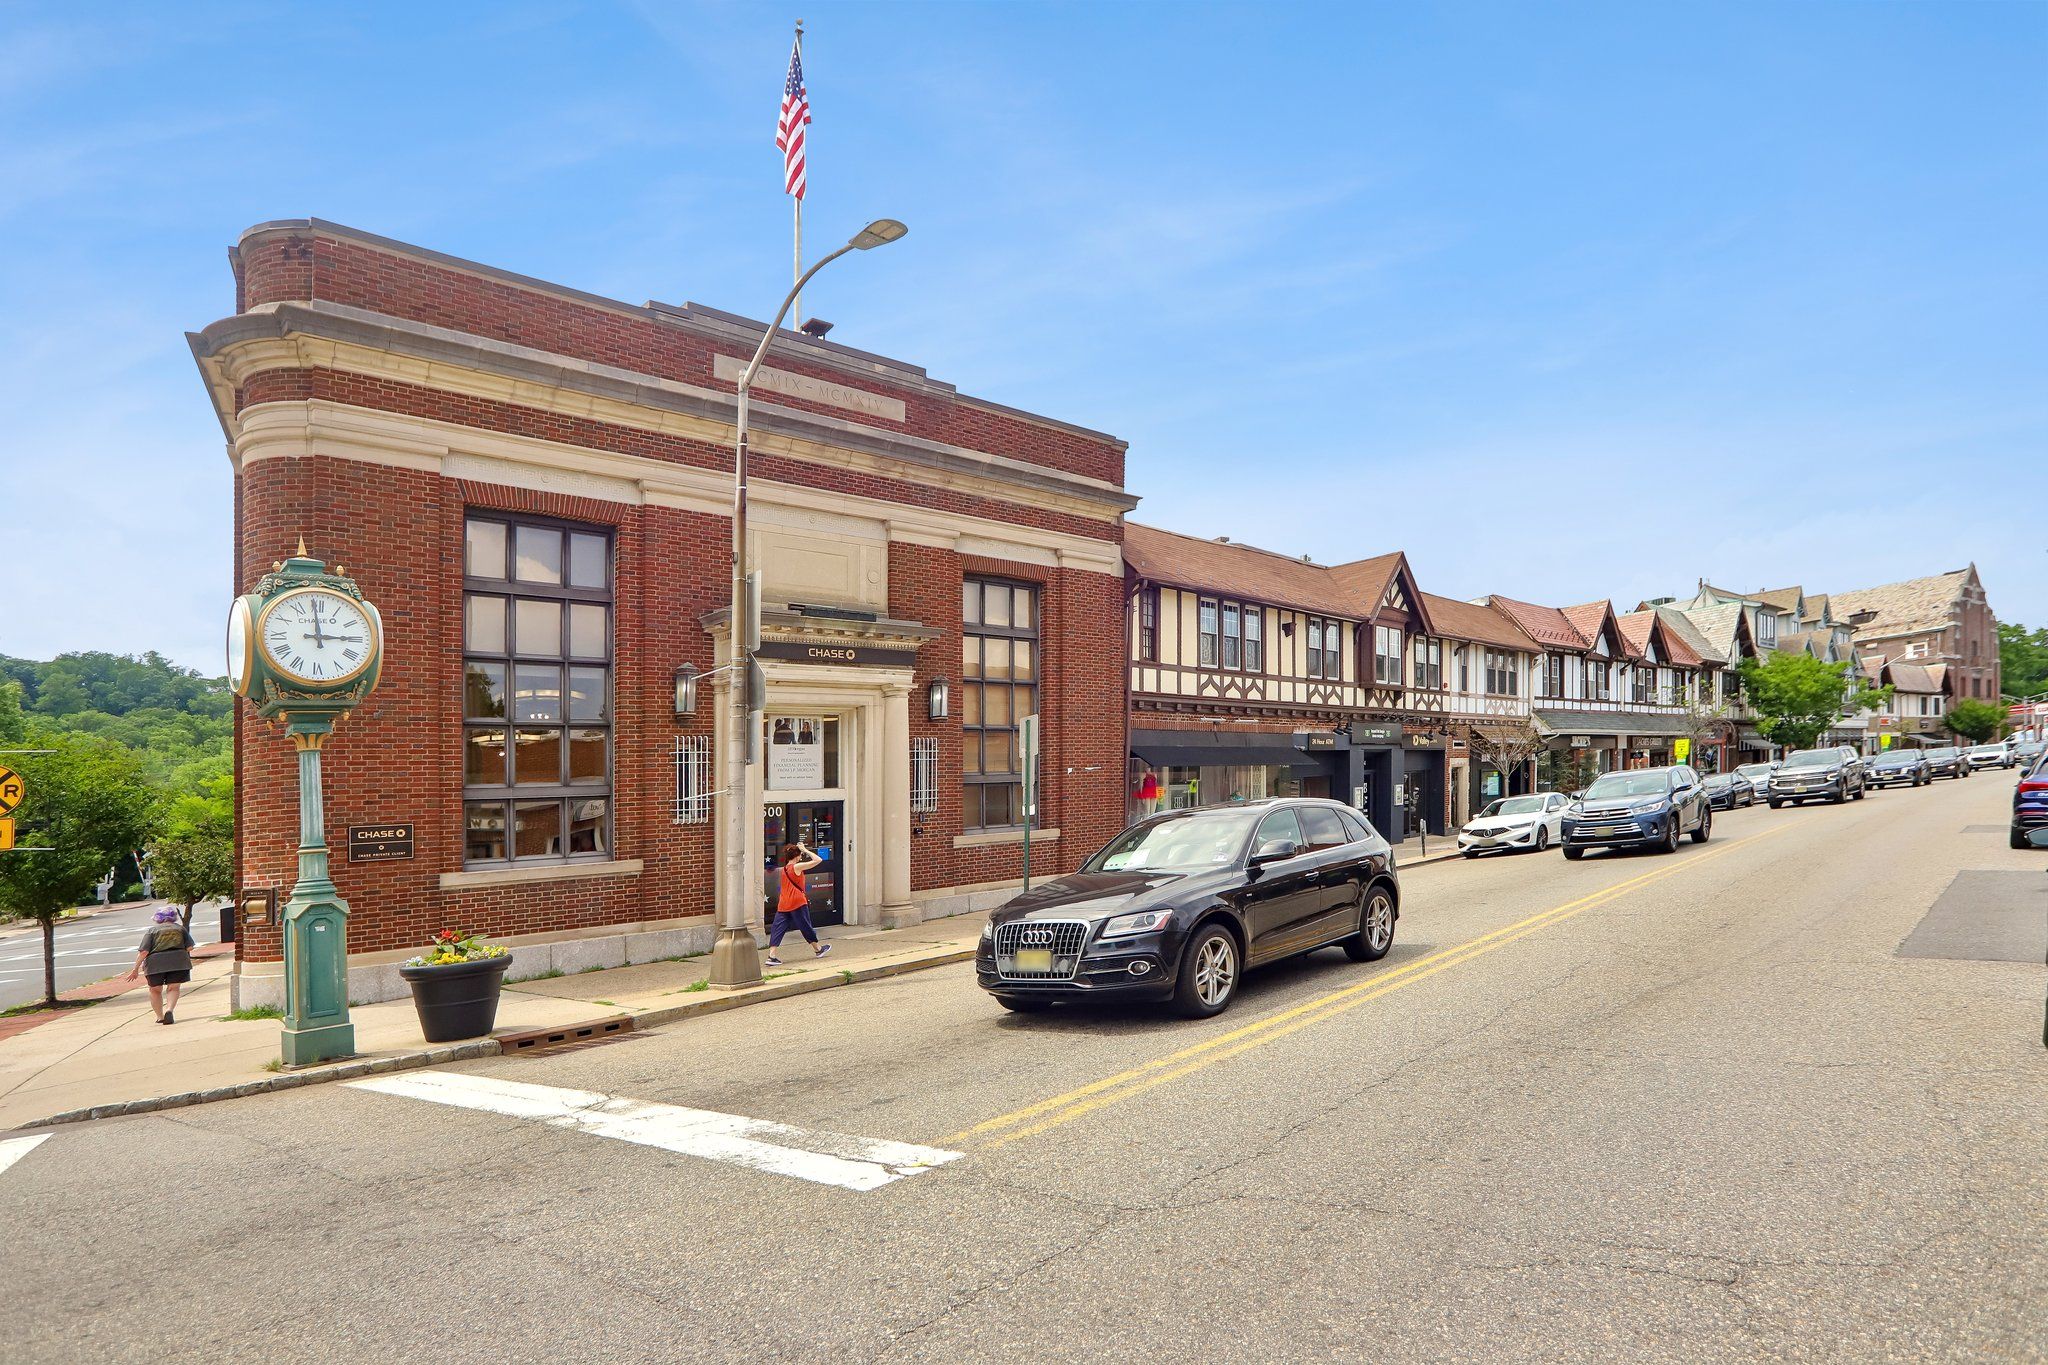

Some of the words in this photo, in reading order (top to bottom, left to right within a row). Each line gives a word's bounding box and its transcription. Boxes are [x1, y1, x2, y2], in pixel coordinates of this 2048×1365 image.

[754, 370, 800, 390] CMIX
[819, 385, 886, 411] MCMXIV
[808, 648, 845, 659] CHASE
[357, 830, 395, 839] CHASE
